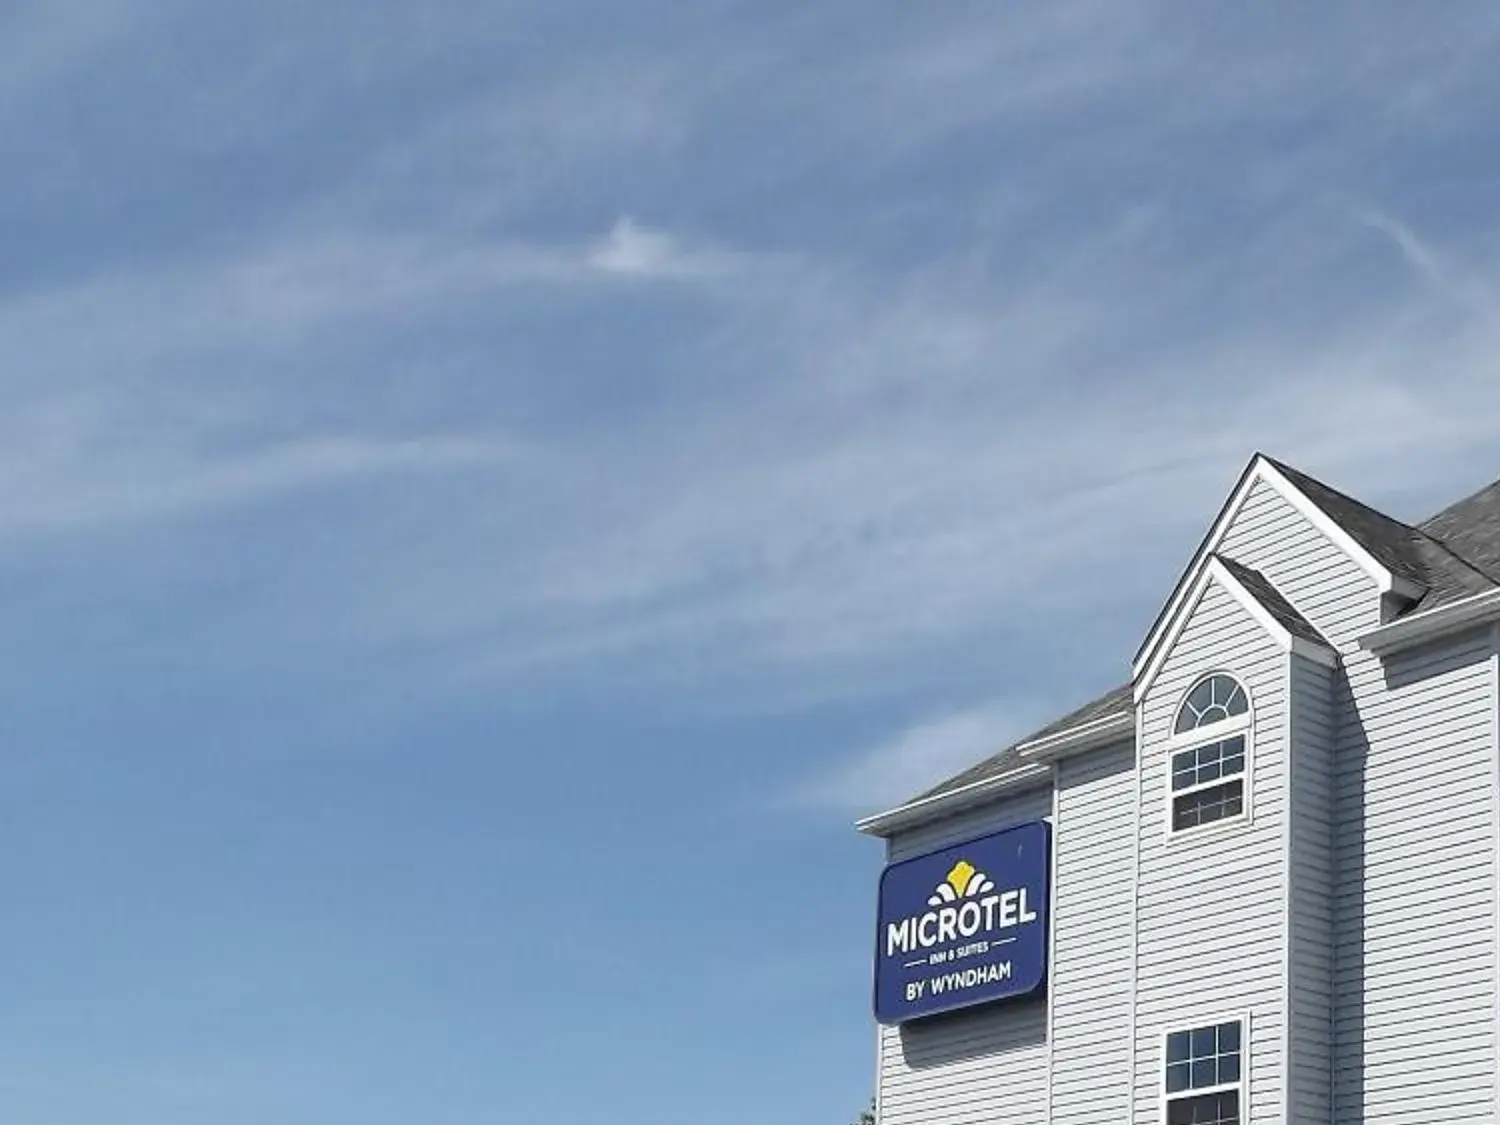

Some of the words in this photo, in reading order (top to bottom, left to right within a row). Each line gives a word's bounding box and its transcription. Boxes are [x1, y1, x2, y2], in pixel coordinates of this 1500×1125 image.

[887, 887, 1037, 956] MICROTEL
[929, 951, 947, 965] INN
[956, 941, 989, 959] SUITES
[906, 980, 925, 1001] BY
[931, 960, 1011, 995] WYNDHAM
